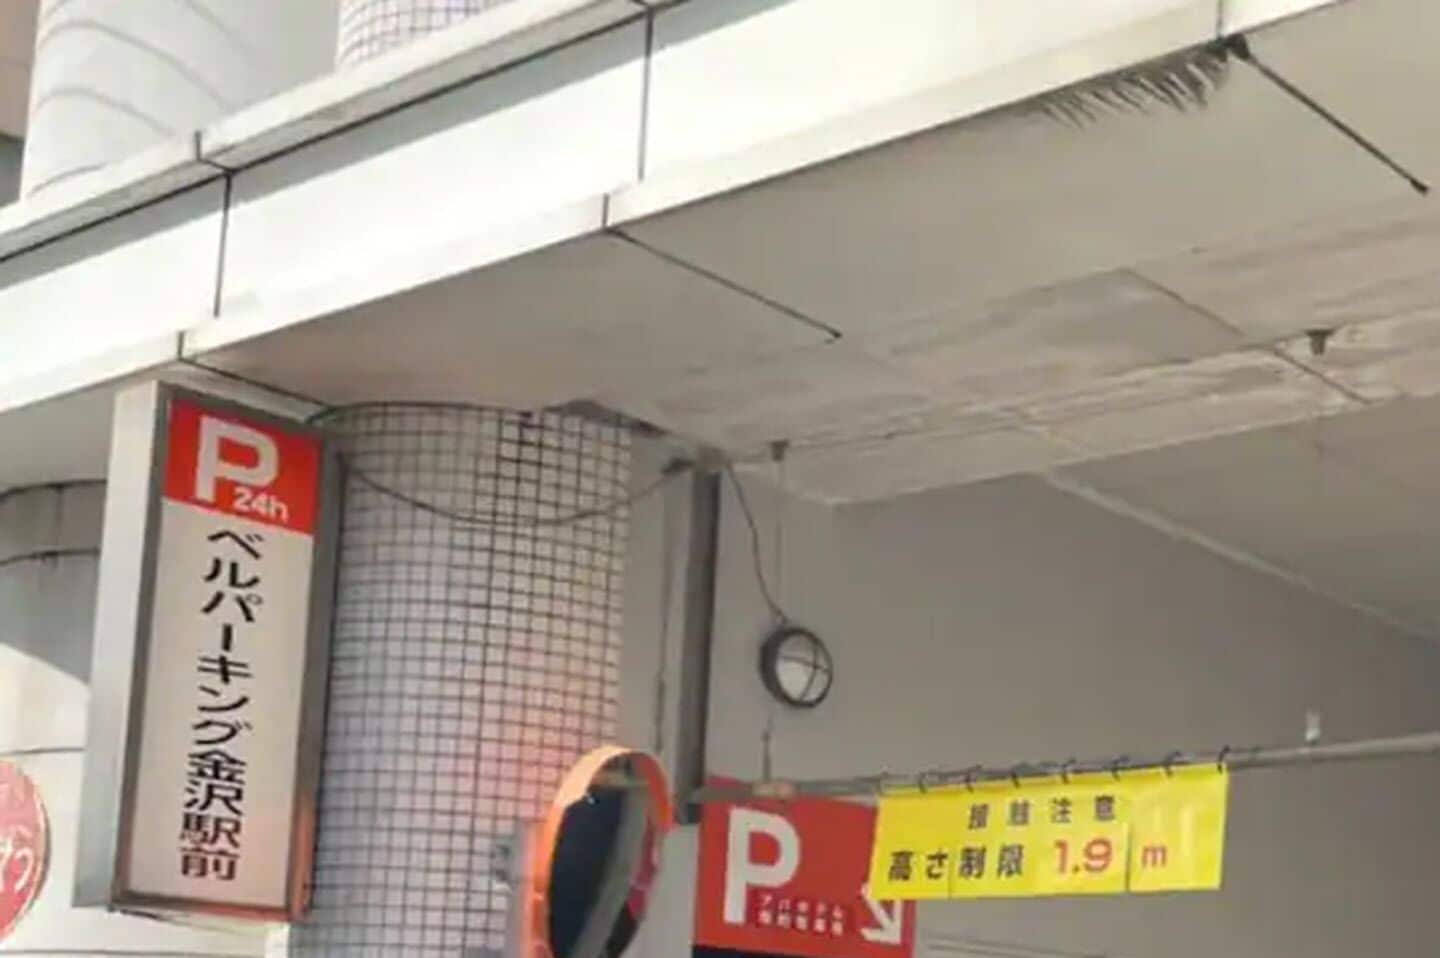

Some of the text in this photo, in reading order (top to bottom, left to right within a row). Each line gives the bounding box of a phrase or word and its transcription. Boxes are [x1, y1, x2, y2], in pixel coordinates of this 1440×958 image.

[195, 414, 279, 503] P
[232, 486, 289, 523] 24h
[179, 530, 264, 881] ベルパーキング金沢駅前
[724, 806, 800, 925] P
[888, 838, 1168, 881] 高さ制限 1.9 m
